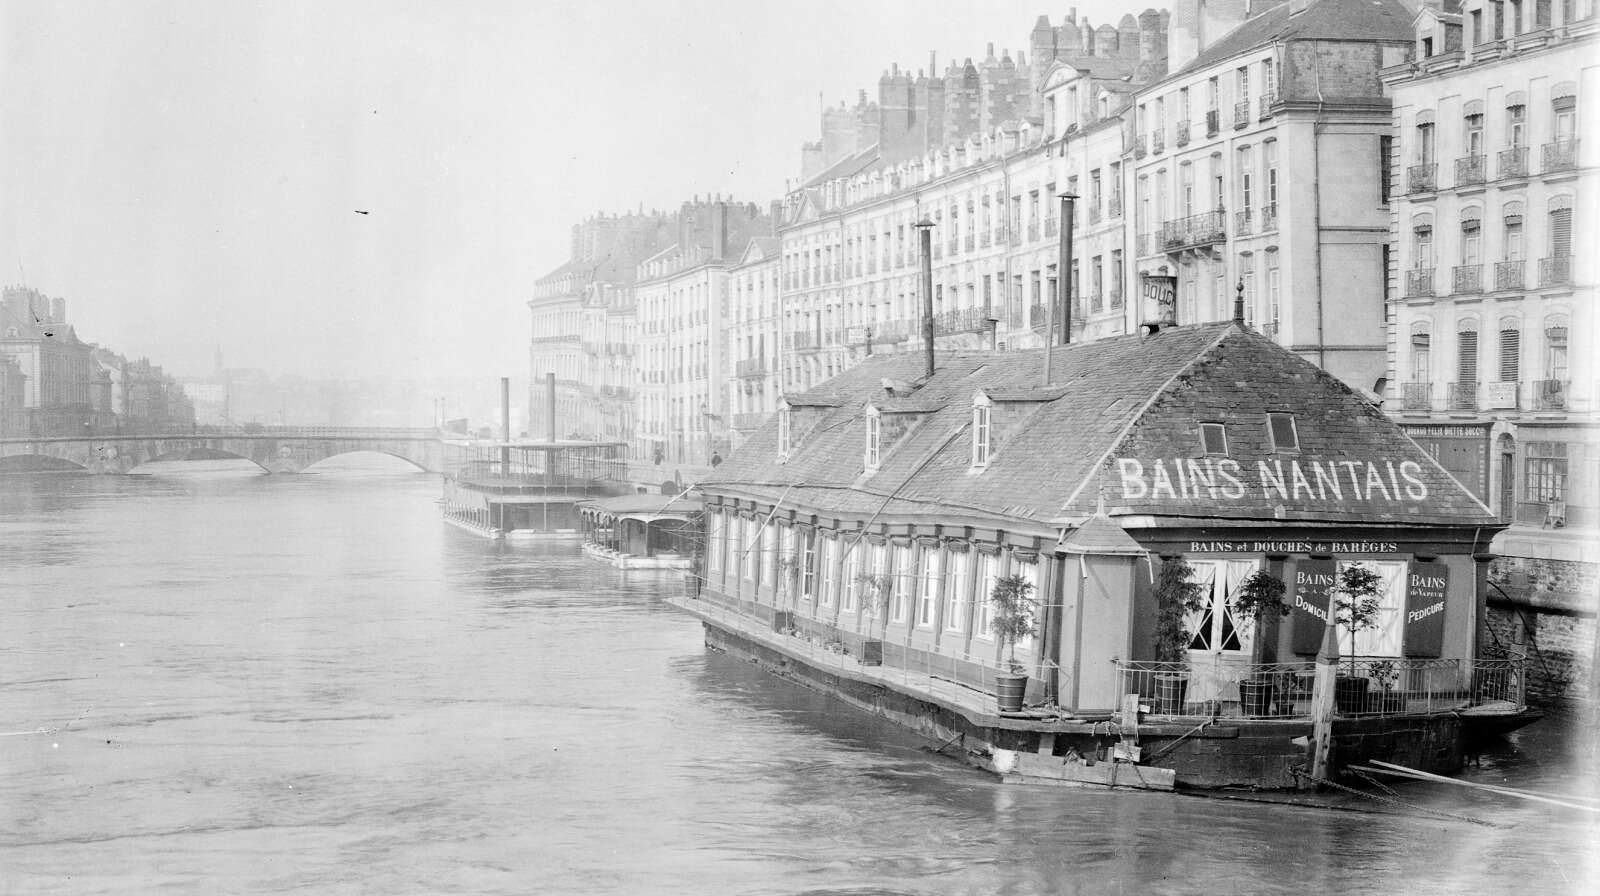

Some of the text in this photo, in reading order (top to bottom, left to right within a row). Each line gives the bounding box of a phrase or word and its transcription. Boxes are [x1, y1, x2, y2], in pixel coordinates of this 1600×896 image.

[1144, 282, 1175, 307] DOUC
[1118, 457, 1246, 500] BAINS
[1257, 458, 1428, 501] NANTAIS
[1191, 541, 1233, 552] BAINS
[1236, 542, 1247, 552] et
[1254, 541, 1313, 552] DOUCHES
[1315, 543, 1327, 553] de
[1296, 571, 1334, 586] BAINS
[1411, 574, 1446, 589] BAINS
[1295, 595, 1328, 622] DOMICIL
